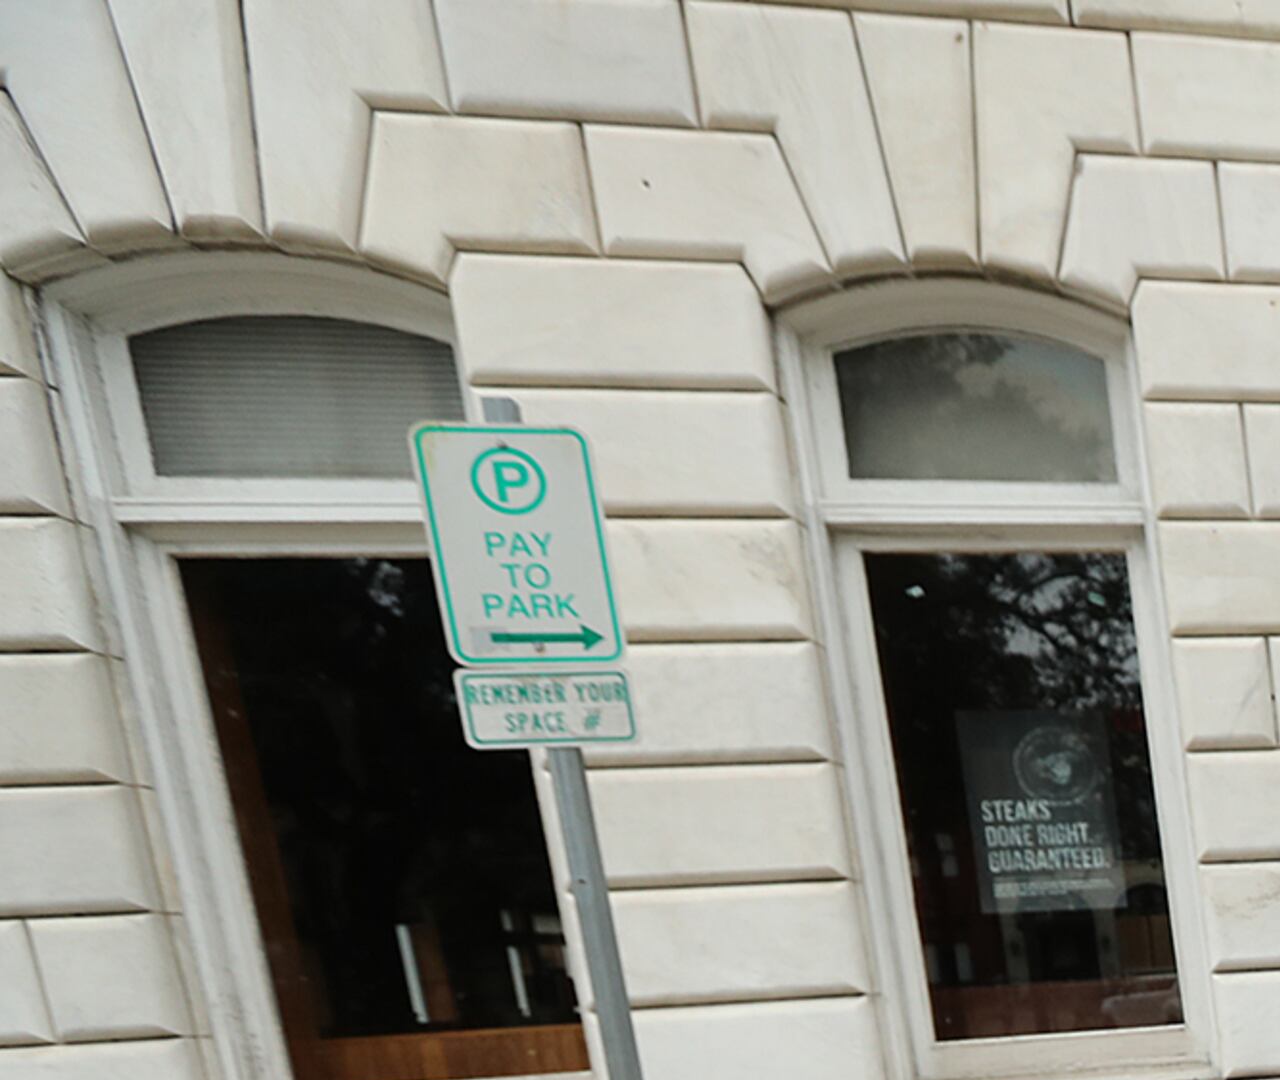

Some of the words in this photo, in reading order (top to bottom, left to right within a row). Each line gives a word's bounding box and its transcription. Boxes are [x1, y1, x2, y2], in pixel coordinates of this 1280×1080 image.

[492, 461, 529, 502] P
[484, 531, 552, 557] PAY
[500, 563, 552, 589] TO
[482, 594, 580, 619] PARK
[464, 683, 567, 705] REMEMBER
[576, 682, 630, 703] YOUR
[505, 712, 566, 733] SPACE
[980, 800, 1052, 822] STEAKS
[984, 824, 1034, 848] DONE
